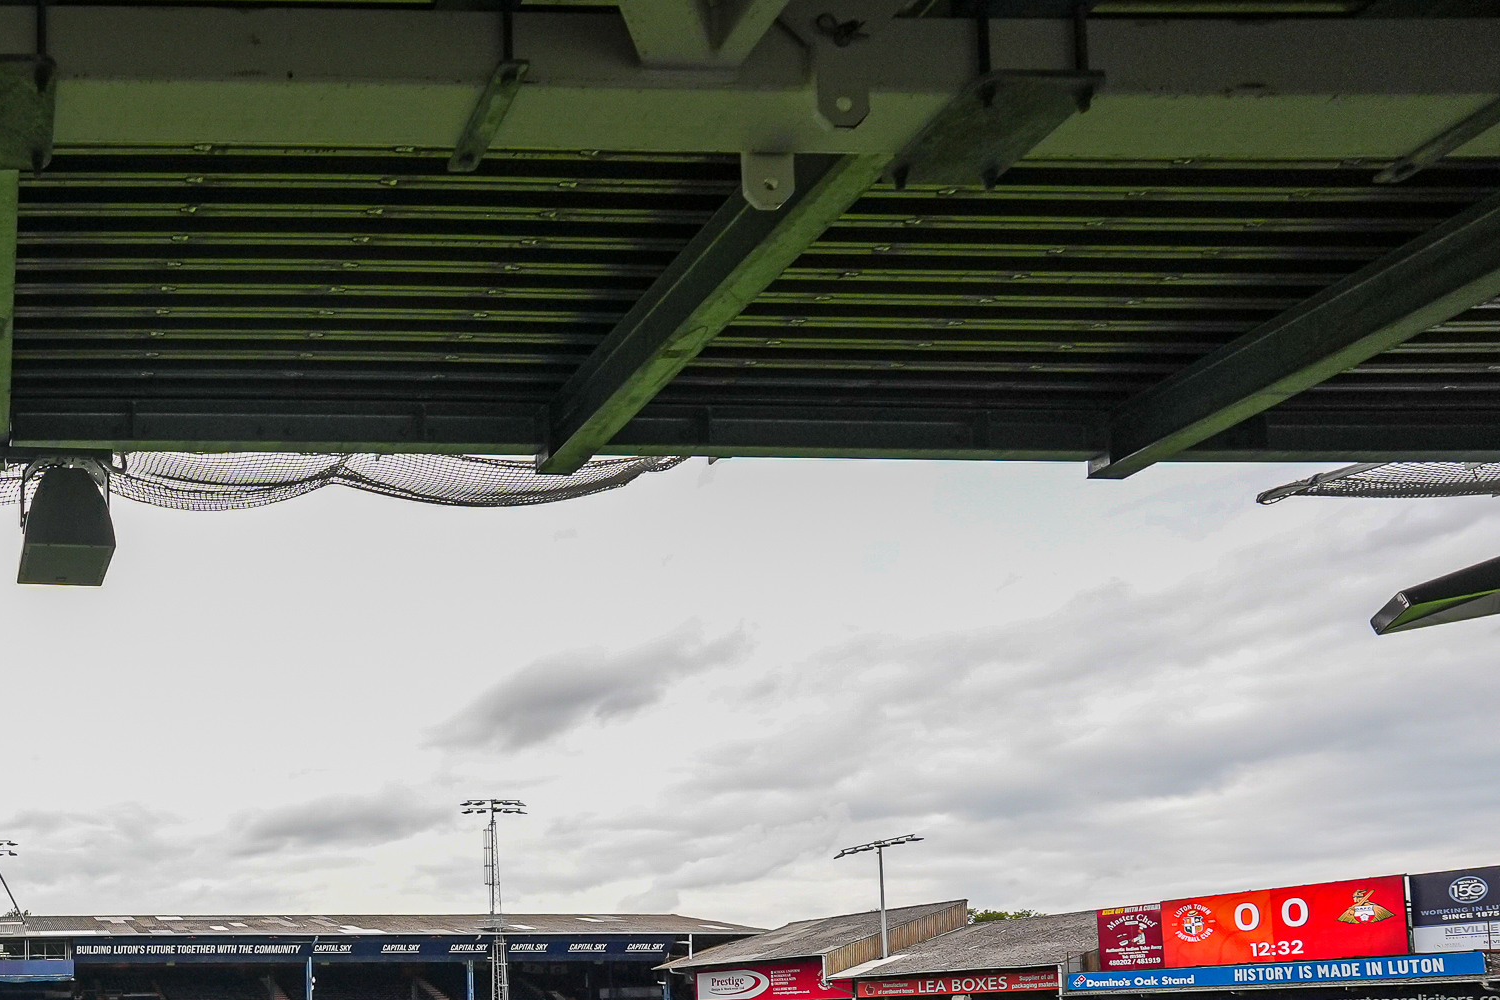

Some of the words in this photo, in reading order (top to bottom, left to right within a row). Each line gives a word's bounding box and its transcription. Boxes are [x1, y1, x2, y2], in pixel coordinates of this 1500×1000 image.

[1451, 883, 1486, 897] 150
[1174, 904, 1193, 918] LUTON
[1193, 903, 1212, 916] TOWN
[1234, 902, 1260, 931] 0
[1281, 897, 1309, 927] 0
[1420, 907, 1468, 916] WORKING
[1442, 912, 1473, 920] SINCE
[1475, 910, 1500, 918] 1875
[1106, 914, 1135, 931] Master
[1136, 913, 1158, 928] Chef
[1174, 929, 1201, 943] FOOTBALL
[1200, 927, 1214, 940] CLUB
[1444, 924, 1499, 935] NEVILLE
[76, 945, 111, 955] BUILDING
[113, 945, 145, 954] LUTON'S
[146, 945, 176, 954] FUTURE
[177, 945, 216, 954] TOGETHER
[217, 945, 237, 954] WITH
[238, 945, 253, 954] THE
[254, 945, 301, 954] COMMUNITY
[314, 944, 339, 952] CAPITAL
[339, 944, 352, 952] SKY
[1249, 939, 1304, 957] 12:32
[1108, 958, 1132, 966] 480202
[1136, 956, 1161, 965] 481919
[1234, 966, 1293, 982] HISTORY
[1298, 965, 1313, 979] IS
[1317, 962, 1361, 978] MADE
[1366, 961, 1383, 976] IN
[1388, 957, 1445, 975] LUTON
[711, 977, 745, 987] Prestige
[918, 980, 946, 993] LEA
[952, 976, 1008, 992] BOXES
[1011, 982, 1038, 990] packaging
[1086, 976, 1131, 988] Domino's
[1134, 976, 1158, 986] Oak
[1161, 974, 1195, 985] Stand
